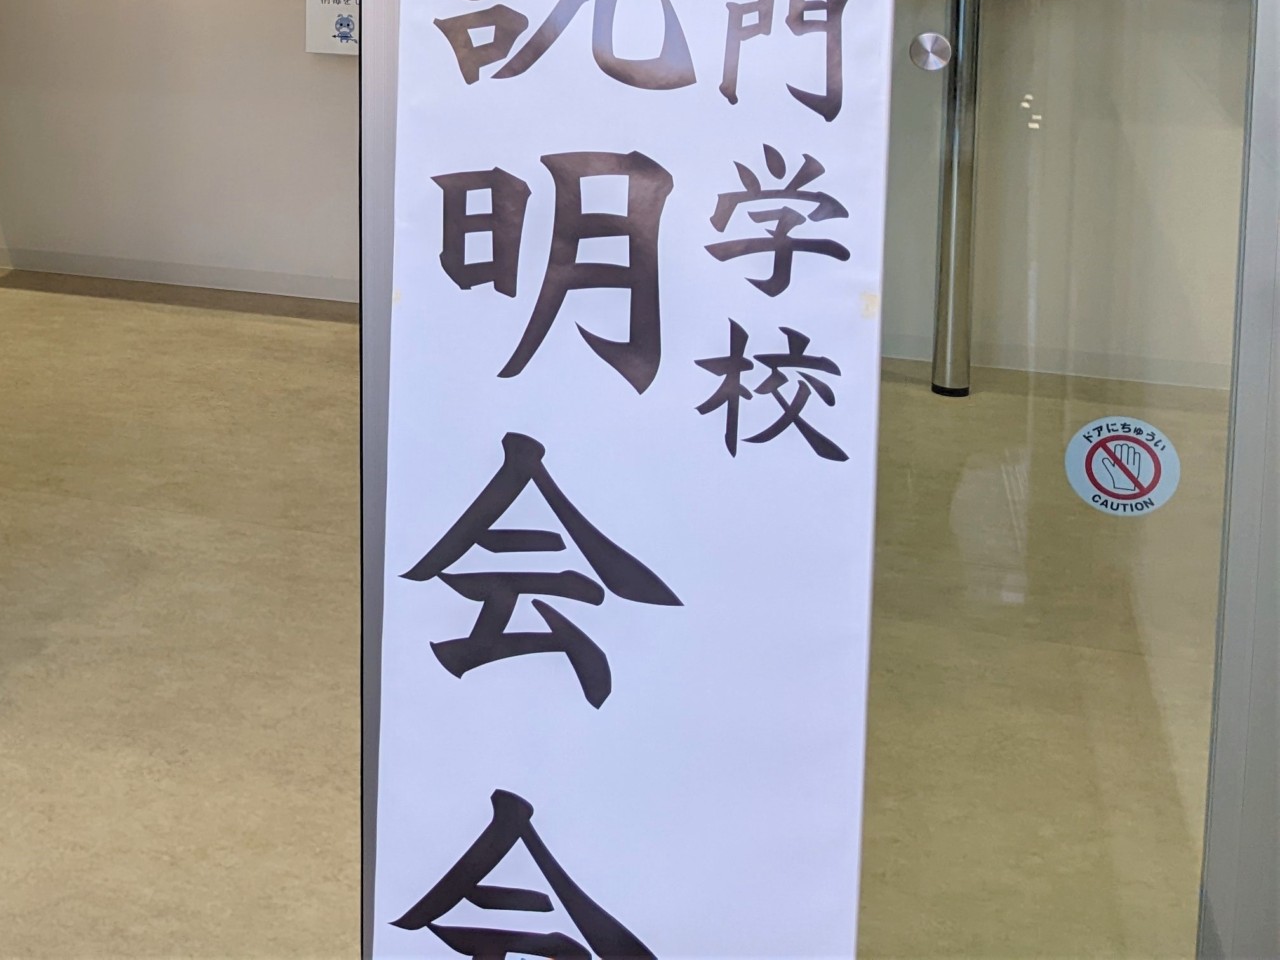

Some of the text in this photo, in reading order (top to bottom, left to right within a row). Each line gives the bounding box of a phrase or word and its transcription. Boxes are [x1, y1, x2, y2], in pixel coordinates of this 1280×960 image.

[1082, 422, 1167, 452] ドアにちゅうい
[1091, 493, 1155, 513] CAUTION
